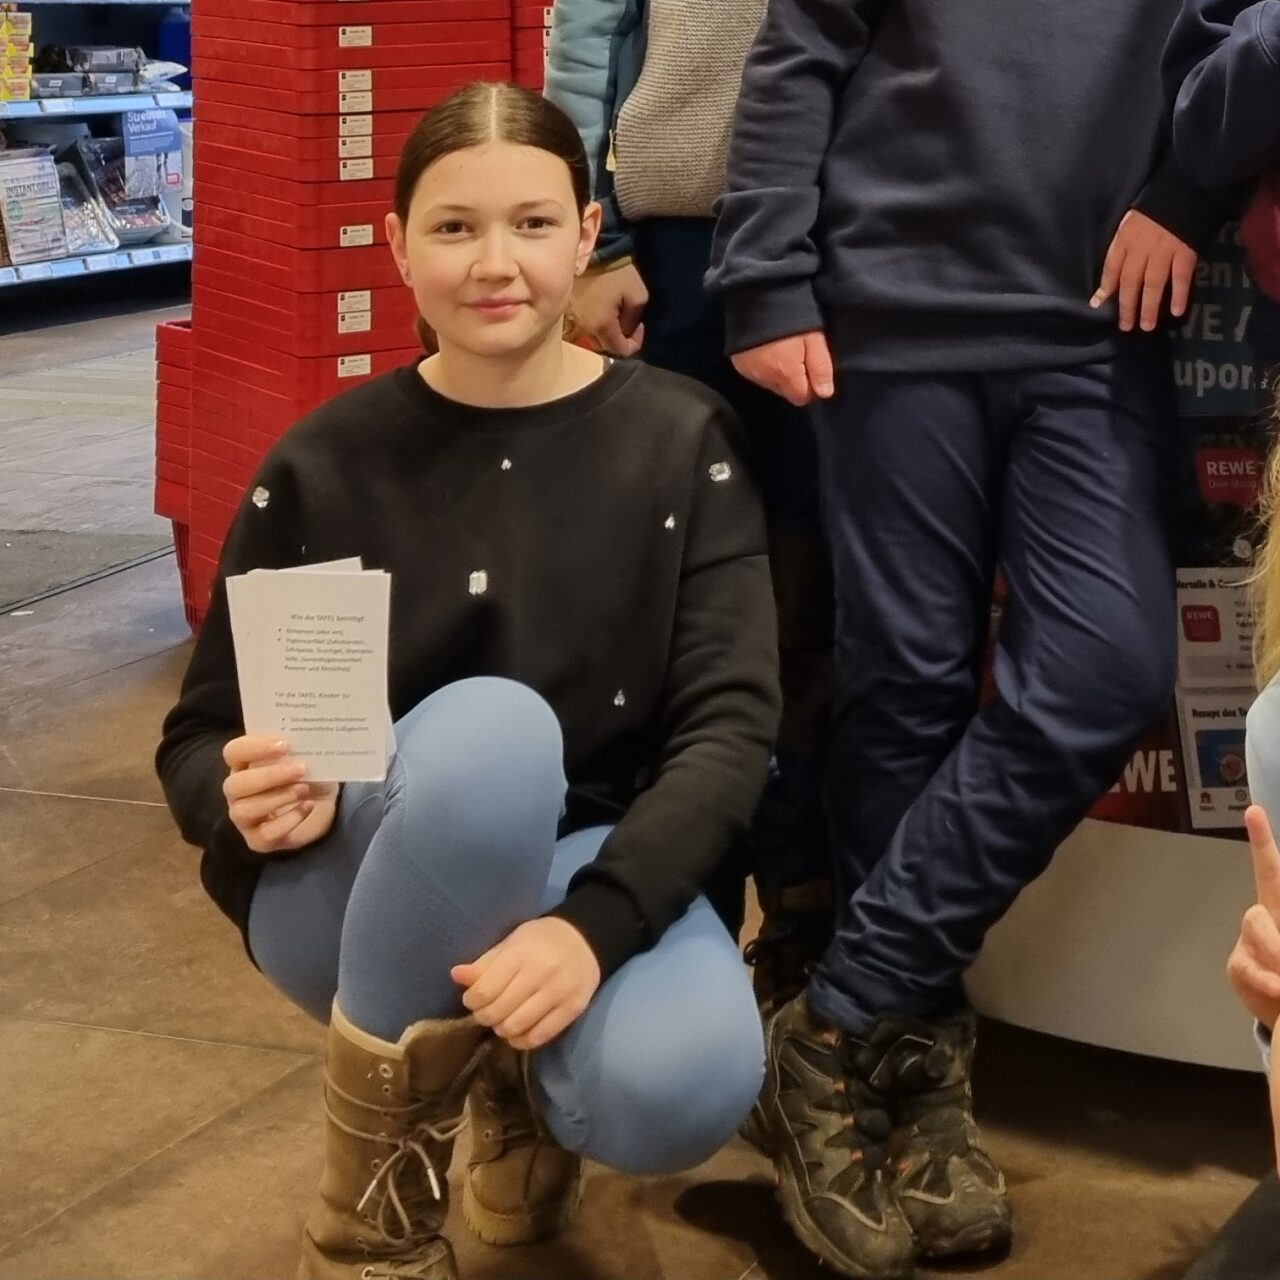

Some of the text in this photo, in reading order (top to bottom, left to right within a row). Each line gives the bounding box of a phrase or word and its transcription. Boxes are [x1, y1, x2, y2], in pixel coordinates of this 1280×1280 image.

[1206, 461, 1257, 476] REWE
[1191, 708, 1221, 720] Rezept
[1222, 708, 1238, 718] des
[1107, 749, 1177, 793] WE
